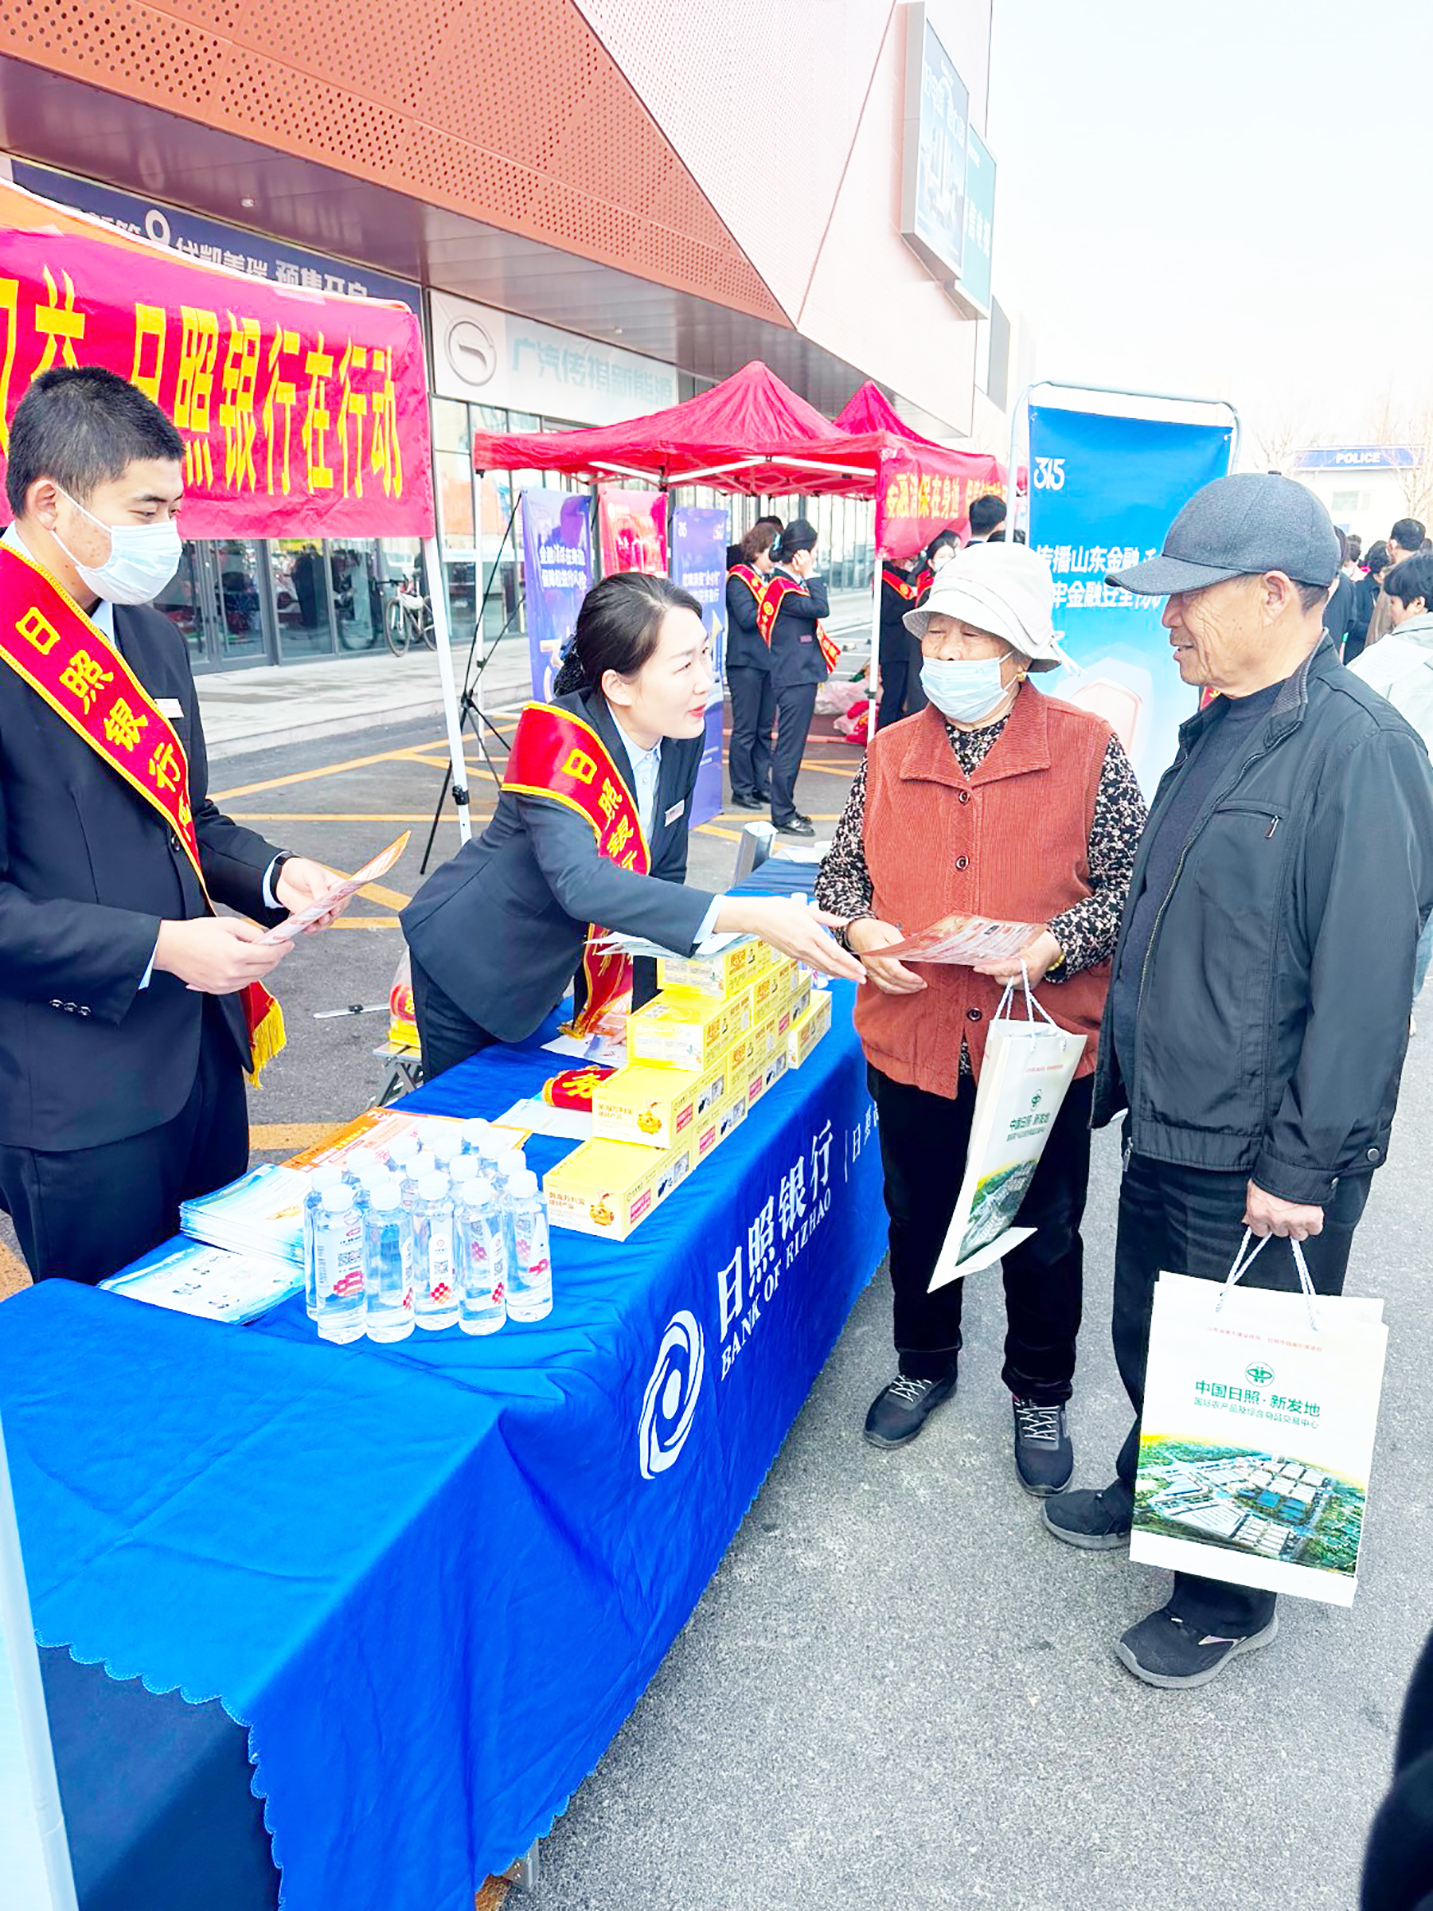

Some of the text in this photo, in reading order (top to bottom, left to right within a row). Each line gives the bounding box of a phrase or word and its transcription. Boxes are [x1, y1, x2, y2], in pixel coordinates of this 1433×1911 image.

[129, 302, 403, 499] 日照银行在行动
[1033, 457, 1066, 491] 315
[1335, 451, 1381, 464] POLICE
[717, 1118, 834, 1344] 日照银行
[720, 1187, 832, 1382] BANK OF RIZHAO
